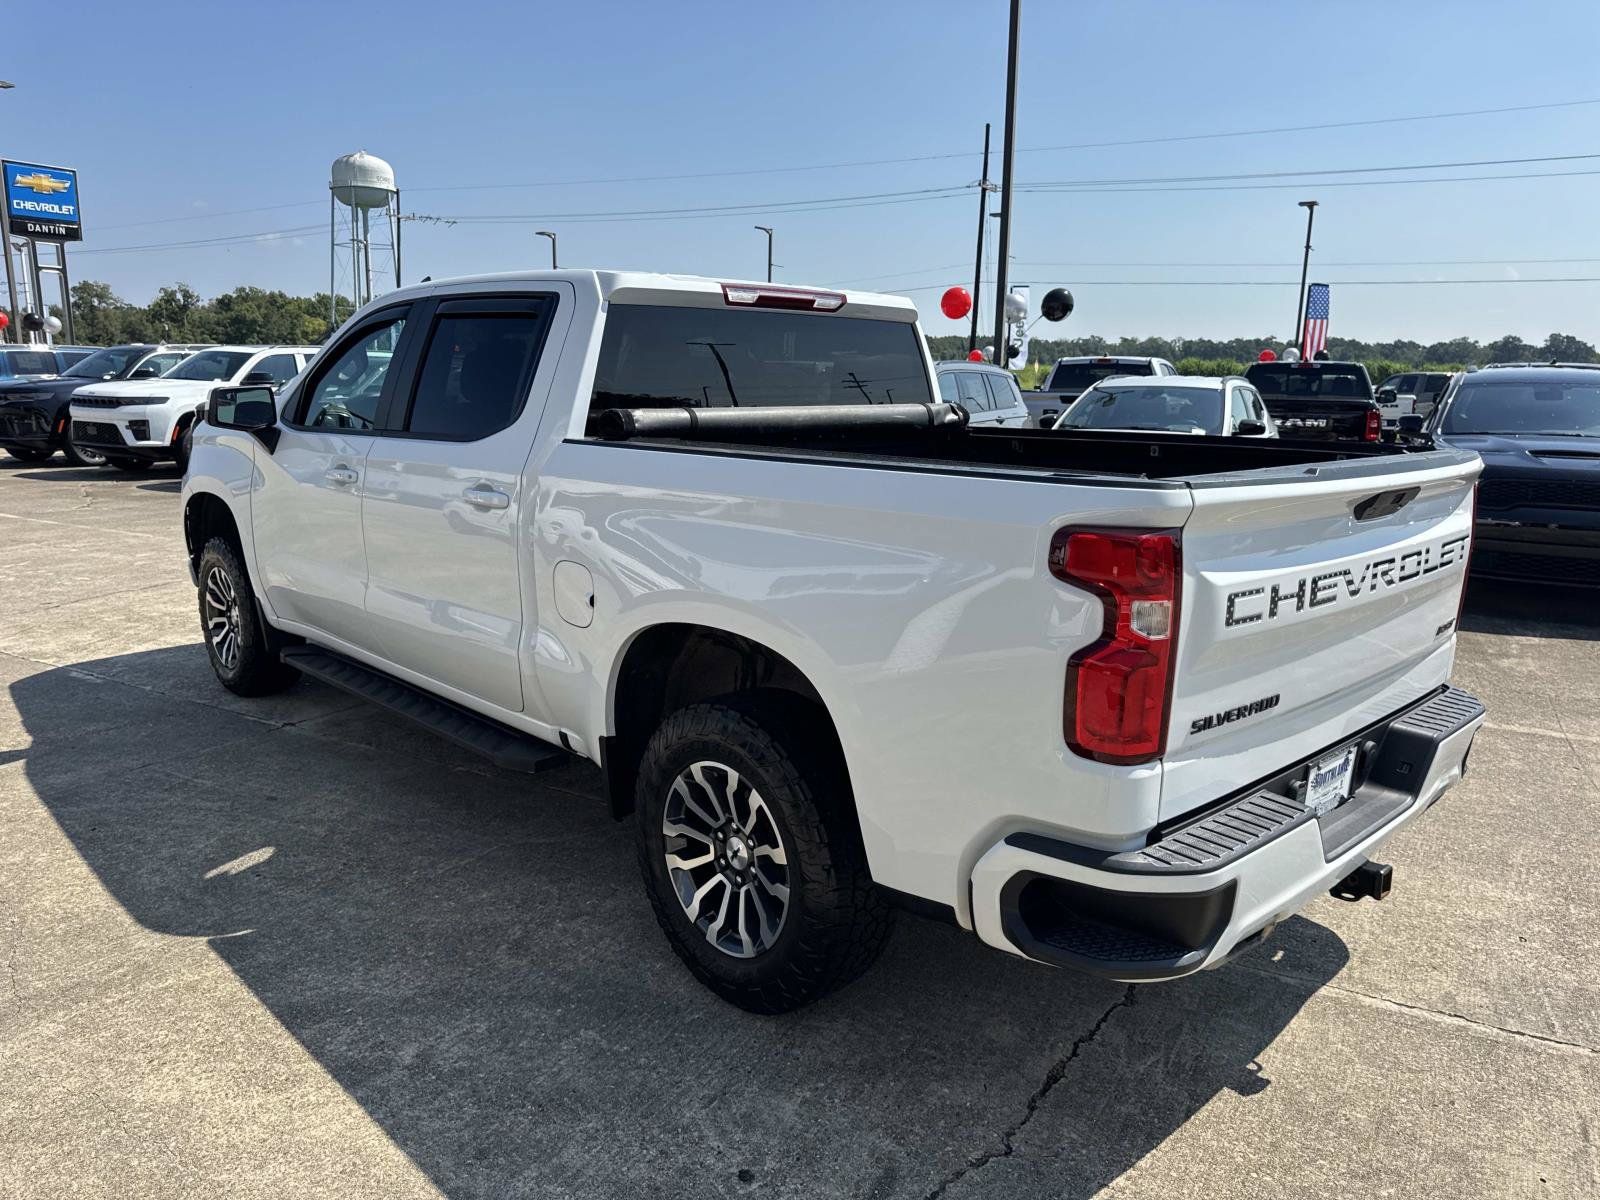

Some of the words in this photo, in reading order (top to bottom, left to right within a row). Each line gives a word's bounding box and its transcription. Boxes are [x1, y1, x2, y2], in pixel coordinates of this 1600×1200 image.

[13, 200, 75, 215] CHEVROLET
[27, 223, 66, 235] DANTIN
[1014, 309, 1027, 348] Jee
[1225, 535, 1470, 627] CHEVROLET
[1190, 694, 1280, 735] SILVERADO
